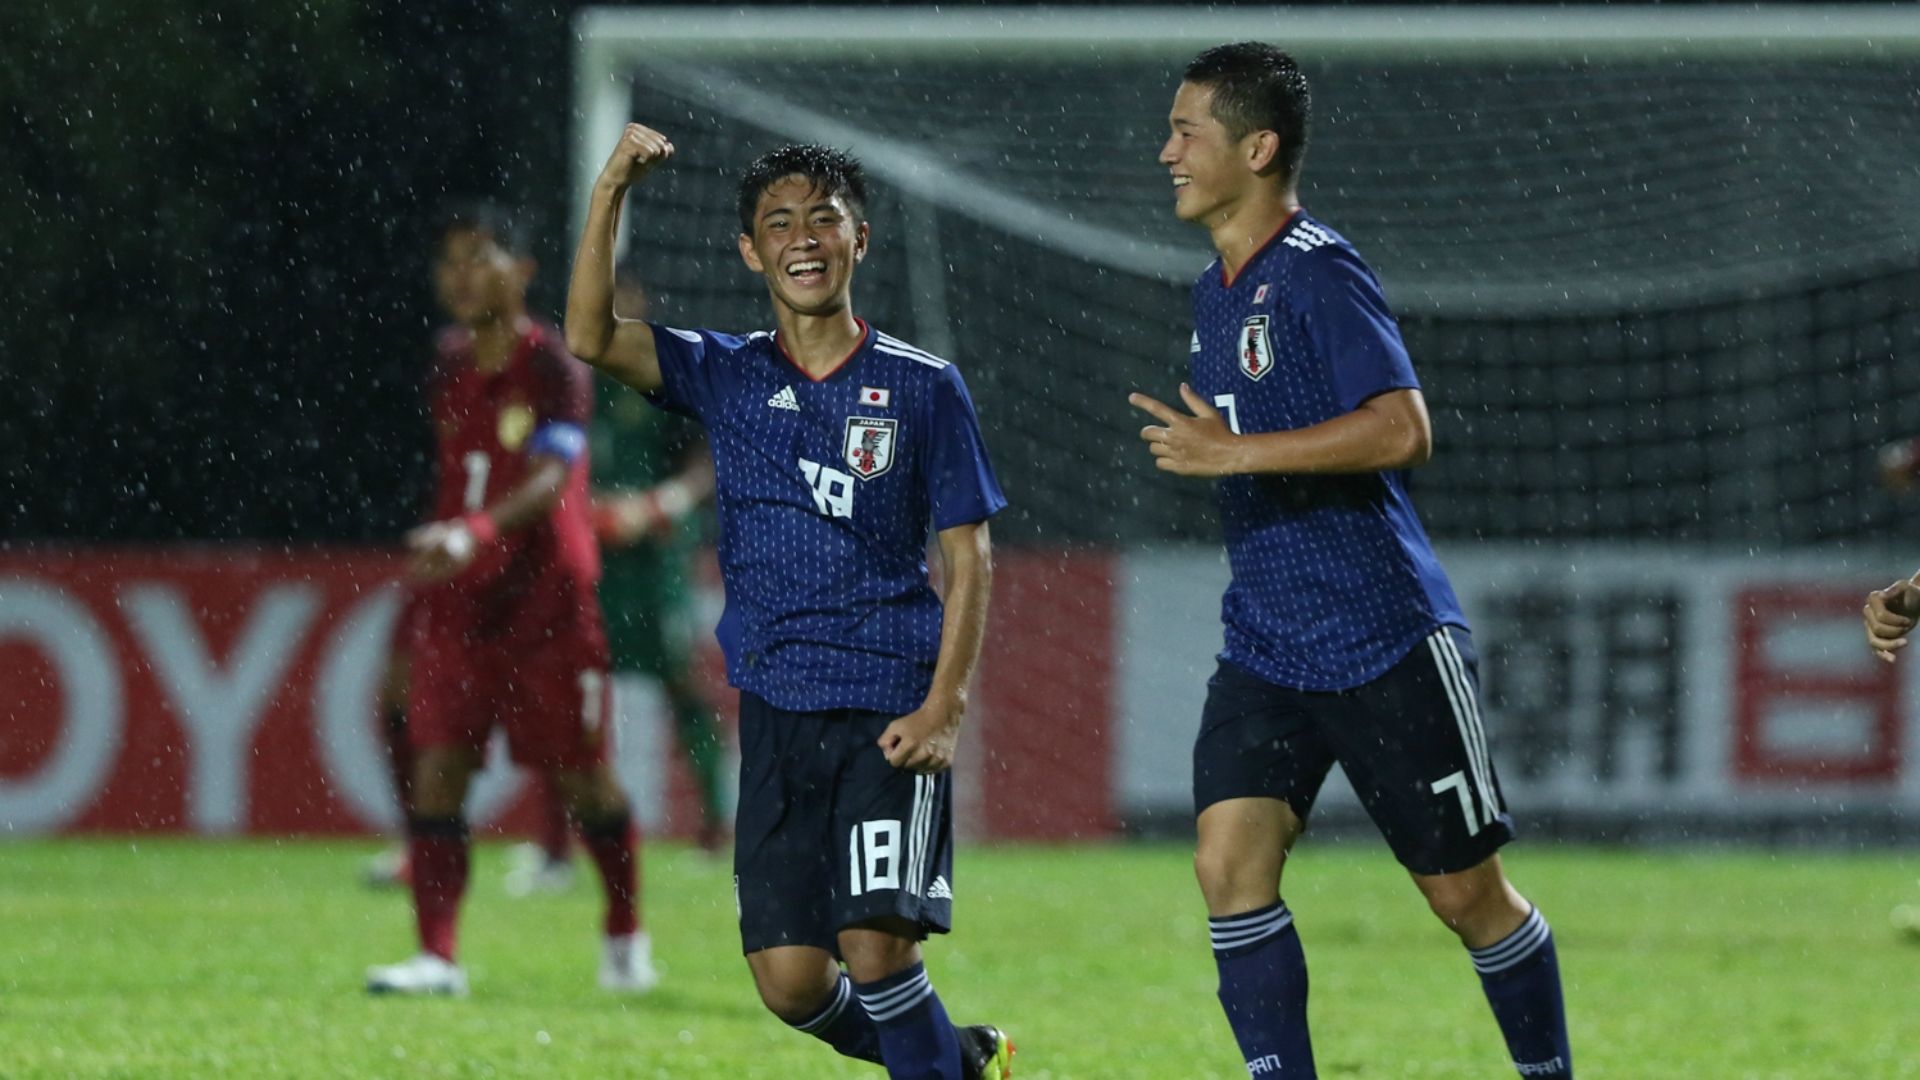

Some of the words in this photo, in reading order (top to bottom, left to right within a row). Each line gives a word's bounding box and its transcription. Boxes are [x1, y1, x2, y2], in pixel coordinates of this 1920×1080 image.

[859, 419, 885, 427] JAPAN
[1213, 393, 1241, 435] 7
[464, 450, 490, 509] 1
[1430, 769, 1480, 837] 7
[850, 819, 901, 897] 18
